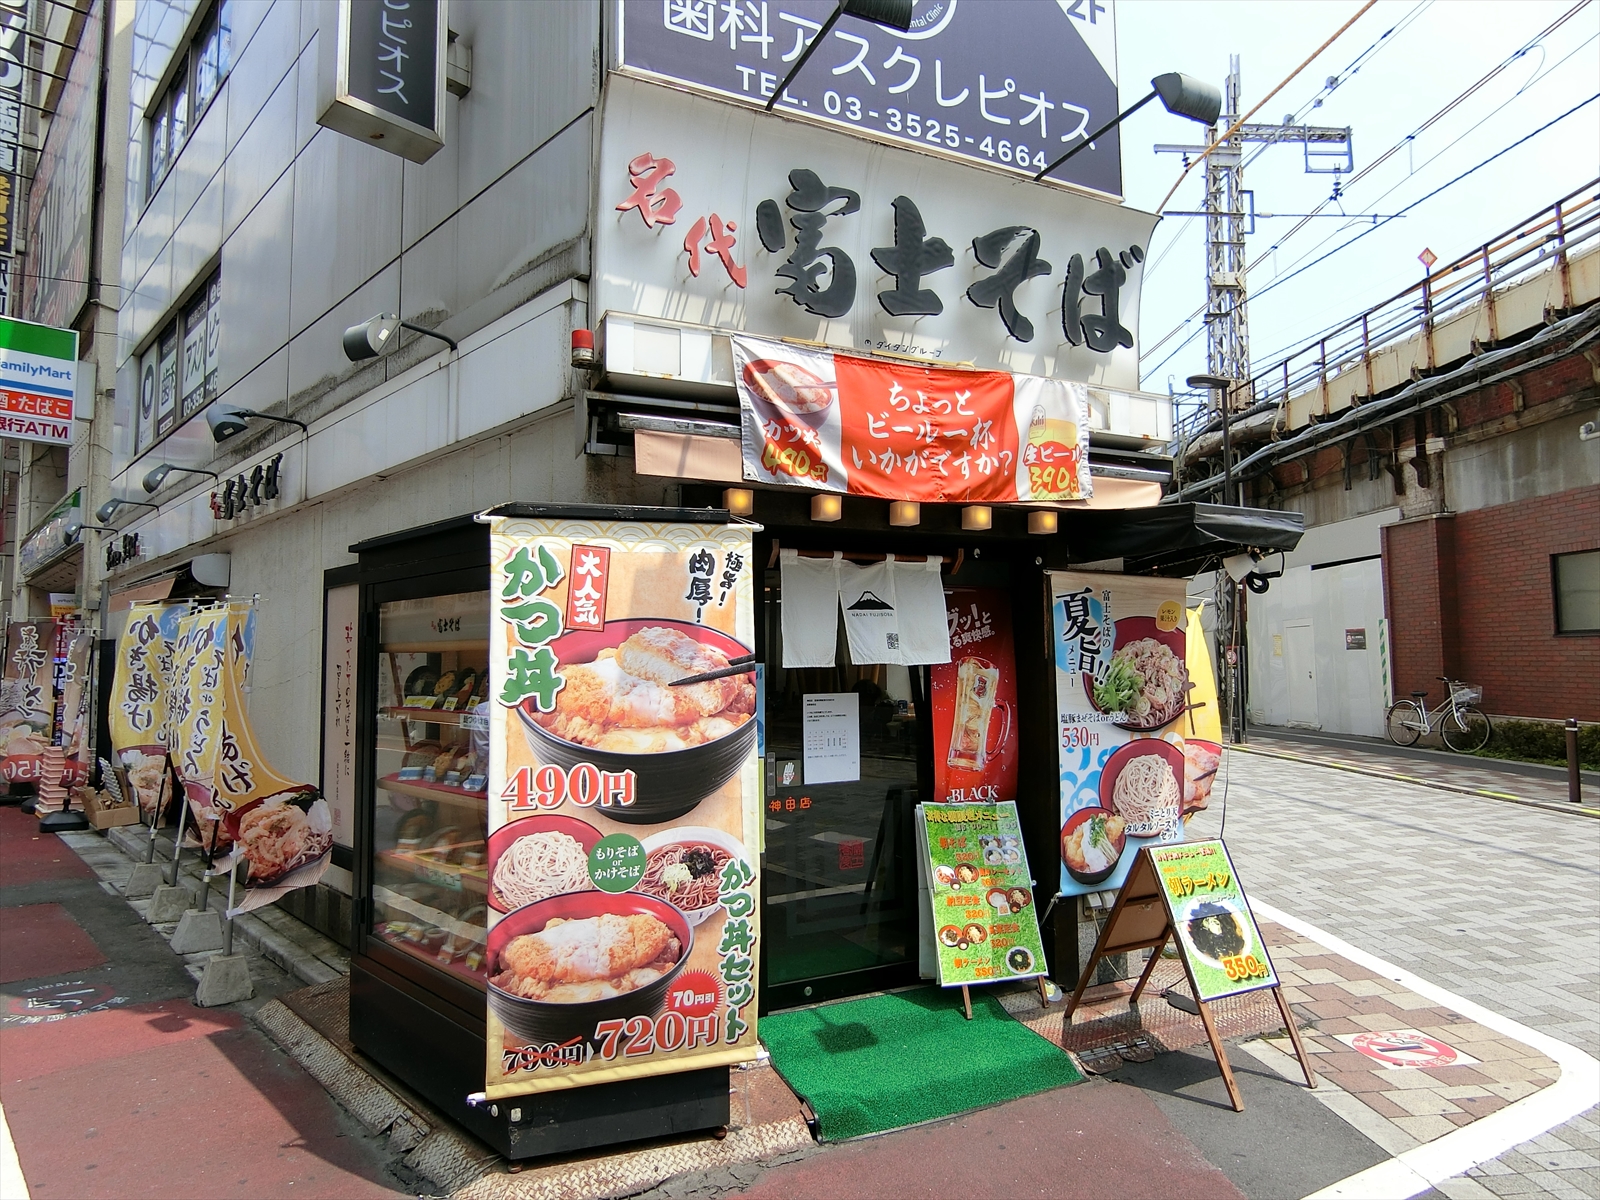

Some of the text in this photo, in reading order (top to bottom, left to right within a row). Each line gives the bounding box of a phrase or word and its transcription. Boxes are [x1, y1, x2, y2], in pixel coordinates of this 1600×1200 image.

[378, 0, 412, 104] ピオス
[735, 64, 1048, 171] TEL. 03-3525-4664
[0, 359, 72, 380] amilyMart
[888, 380, 975, 417] ちょっと
[866, 411, 996, 450] ビール一杯
[573, 551, 603, 626] 大人気
[1062, 726, 1099, 748] 530円
[500, 763, 637, 811] 490円
[950, 784, 998, 802] BLACK
[768, 796, 813, 812] 神田店
[596, 845, 639, 860] もりそば
[594, 865, 641, 880] かけそば
[1167, 872, 1231, 898] 朝ラーメン
[1221, 954, 1270, 982] 350円
[673, 989, 715, 1008] 70円引
[594, 1011, 720, 1061] 720円
